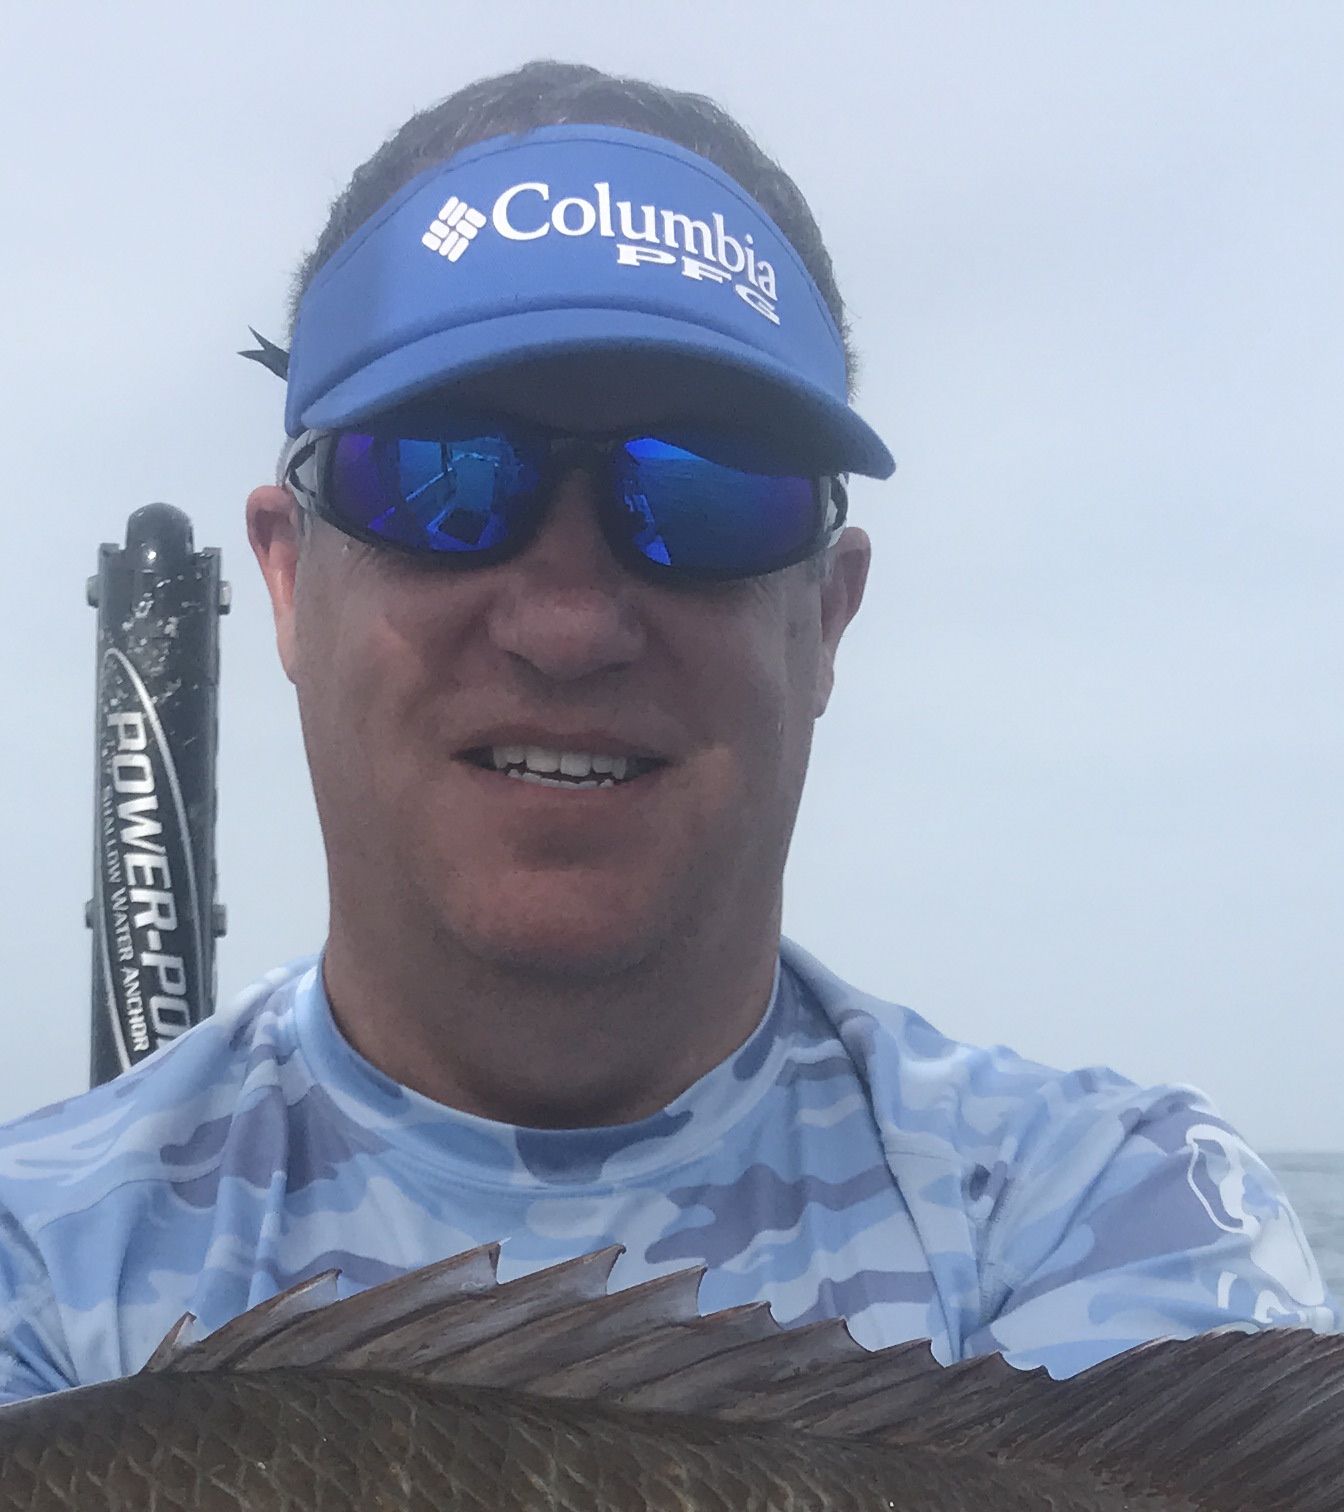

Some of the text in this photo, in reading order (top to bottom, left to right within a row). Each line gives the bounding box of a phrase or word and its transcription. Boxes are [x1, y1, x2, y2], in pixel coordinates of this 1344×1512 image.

[492, 181, 779, 302] Columbia
[615, 243, 781, 326] PFG
[107, 712, 191, 1049] POWER-PO
[111, 887, 134, 962] WATER
[120, 967, 150, 1052] ANCHOR
